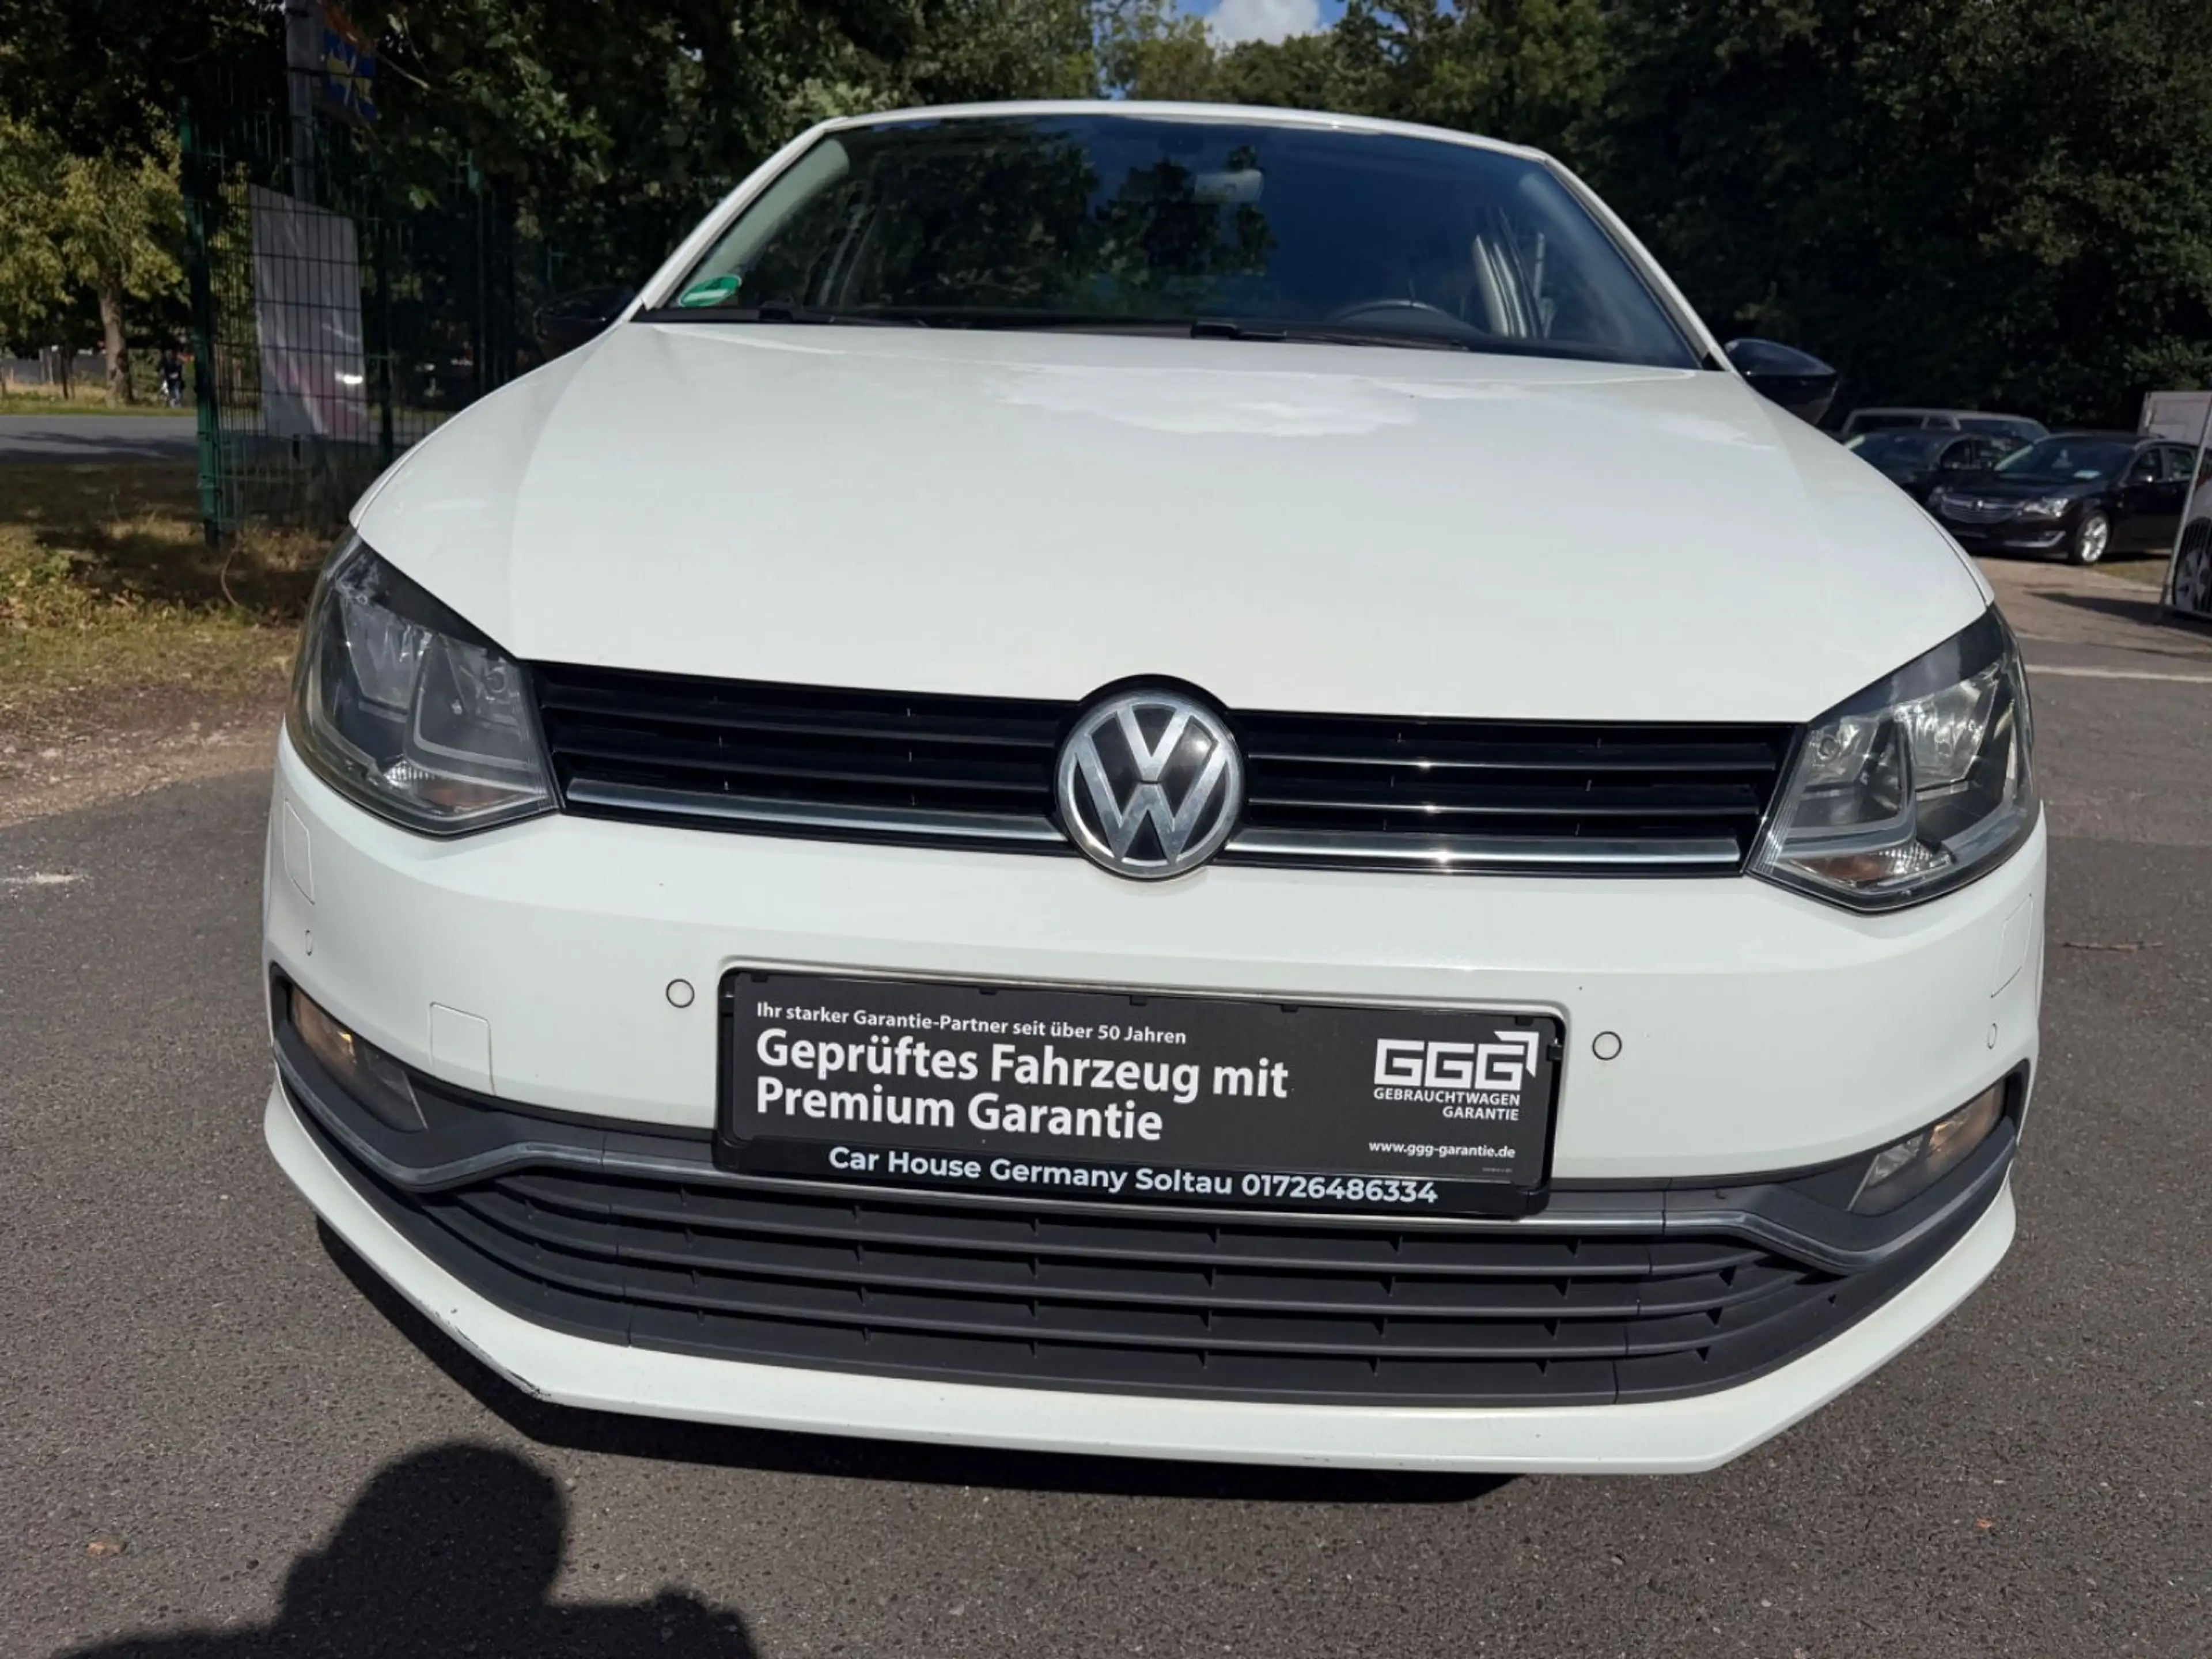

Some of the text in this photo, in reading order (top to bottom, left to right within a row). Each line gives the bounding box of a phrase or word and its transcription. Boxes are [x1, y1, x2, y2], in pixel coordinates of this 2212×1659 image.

[1070, 702, 1229, 864] VW
[756, 1001, 1187, 1045] Ihr starker Garantie-Partner seit über 50 Jahren
[756, 1027, 1290, 1104] Geprüftes Fahrzeug mit
[1373, 1037, 1526, 1092] GGG
[756, 1075, 1164, 1142] Premium Garantie
[1373, 1086, 1521, 1107] GEBRAUCHTWAGEN
[1441, 1105, 1520, 1122] GARANTIE
[828, 1146, 1438, 1203] Car House Germany Soltau 01726486334
[1368, 1141, 1517, 1159] www.ggg-garantie.de
